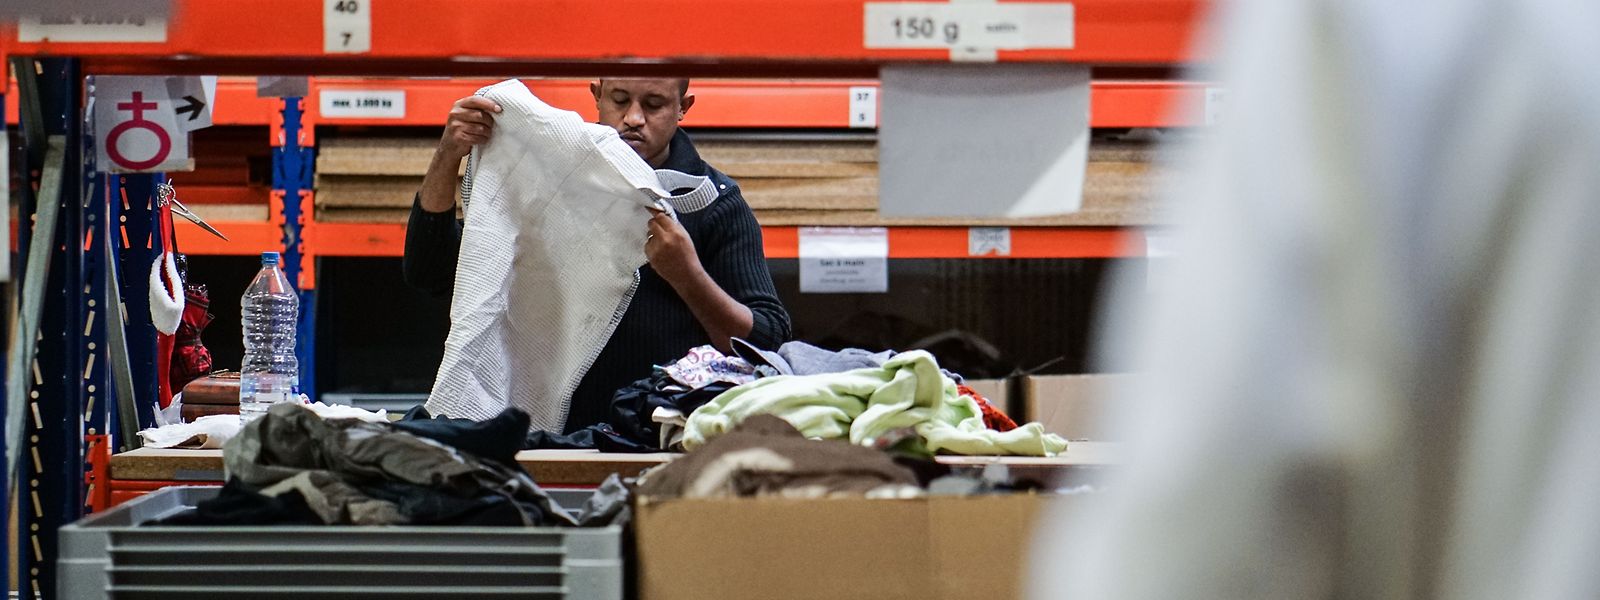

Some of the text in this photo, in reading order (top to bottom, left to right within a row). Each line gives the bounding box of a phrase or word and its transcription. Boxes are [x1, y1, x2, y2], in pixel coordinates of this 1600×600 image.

[333, 0, 359, 14] 40
[892, 17, 960, 43] 150 g
[341, 31, 351, 47] 7
